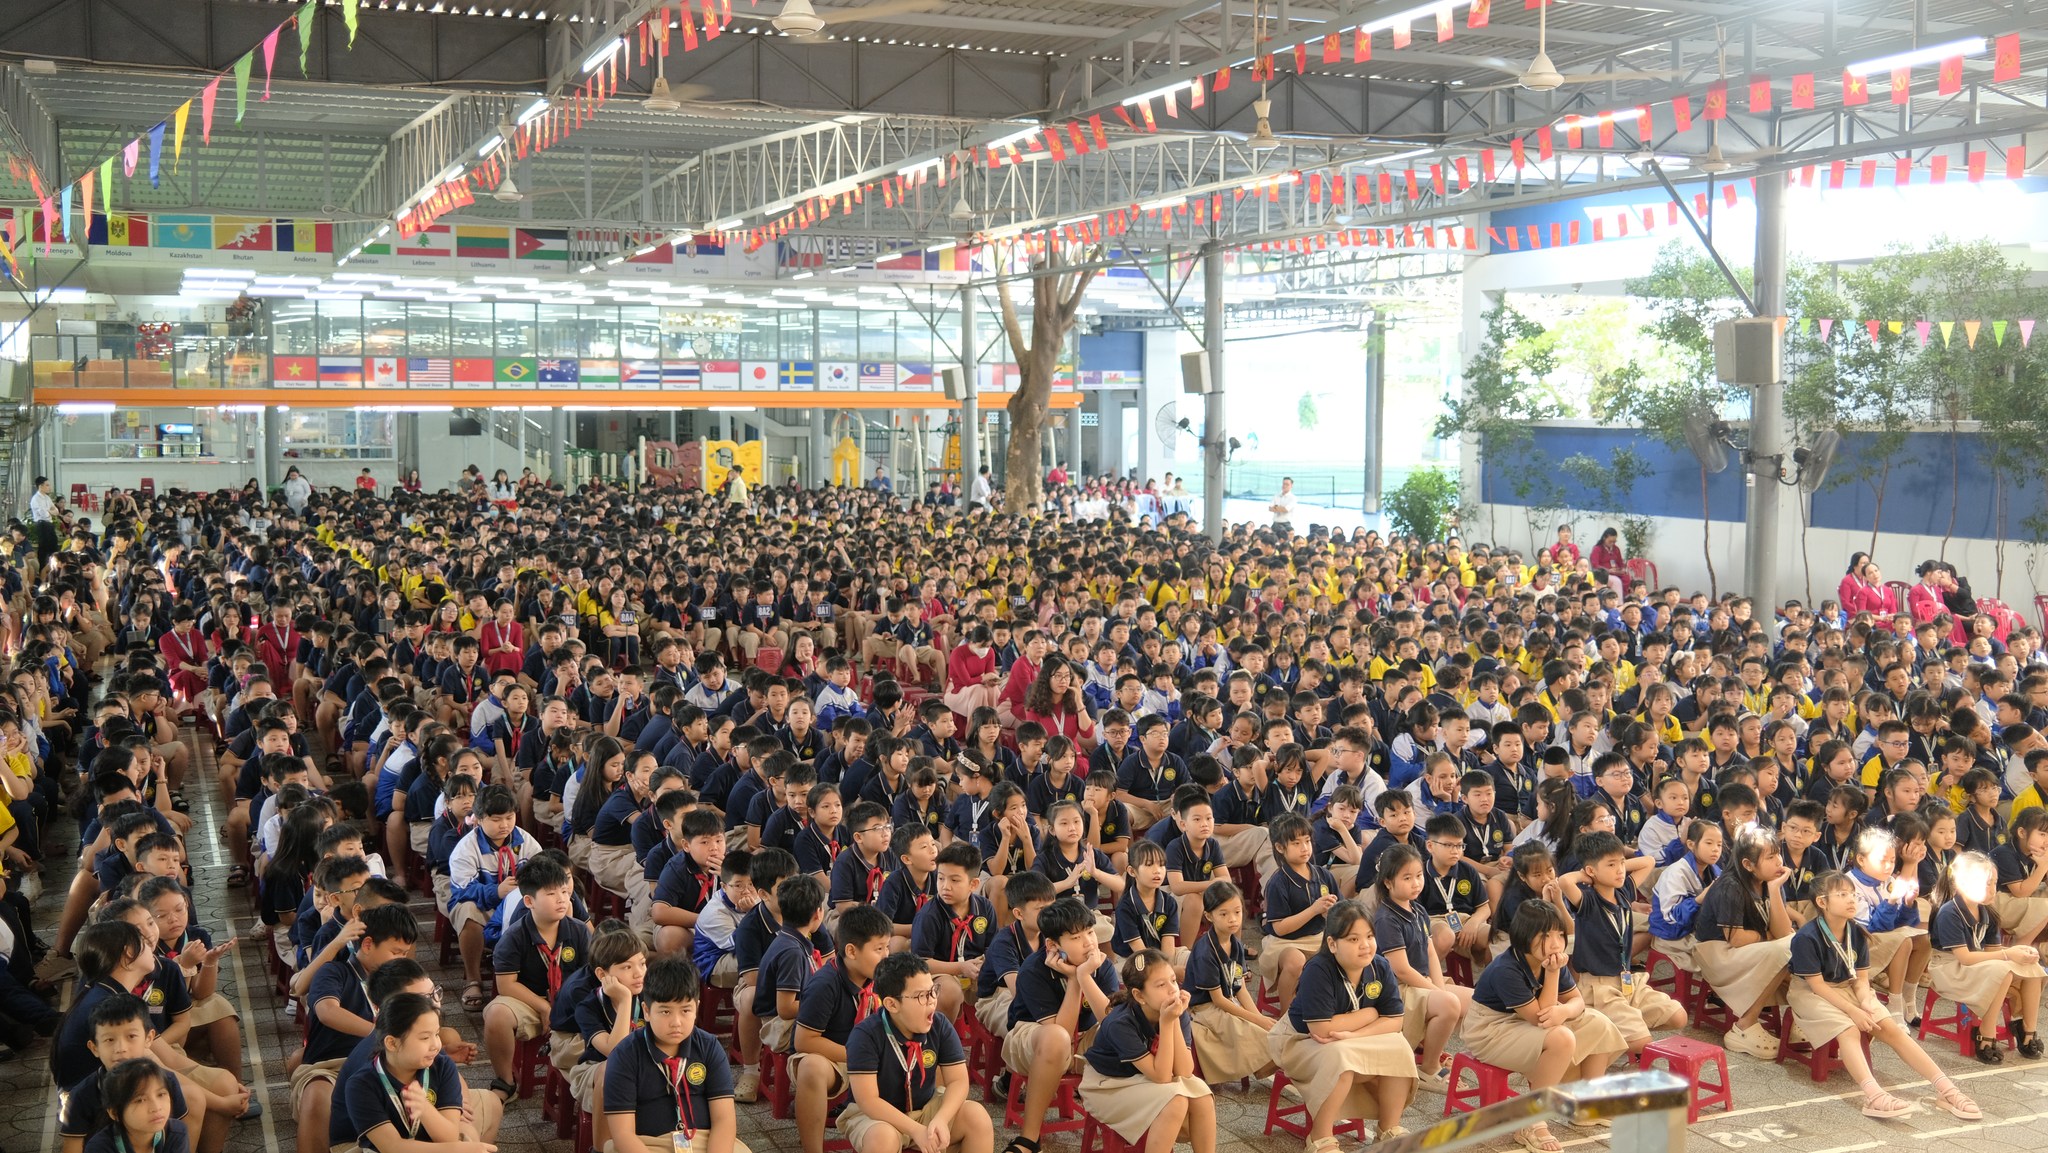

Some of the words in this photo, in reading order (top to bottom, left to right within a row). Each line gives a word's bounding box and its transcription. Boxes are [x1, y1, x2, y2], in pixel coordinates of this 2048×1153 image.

[36, 247, 74, 255] Motenegro
[105, 249, 133, 257] Moldova
[703, 609, 715, 618] 8A3
[758, 607, 771, 616] 8A2
[817, 606, 829, 615] 8A1
[620, 613, 634, 622] 8A4
